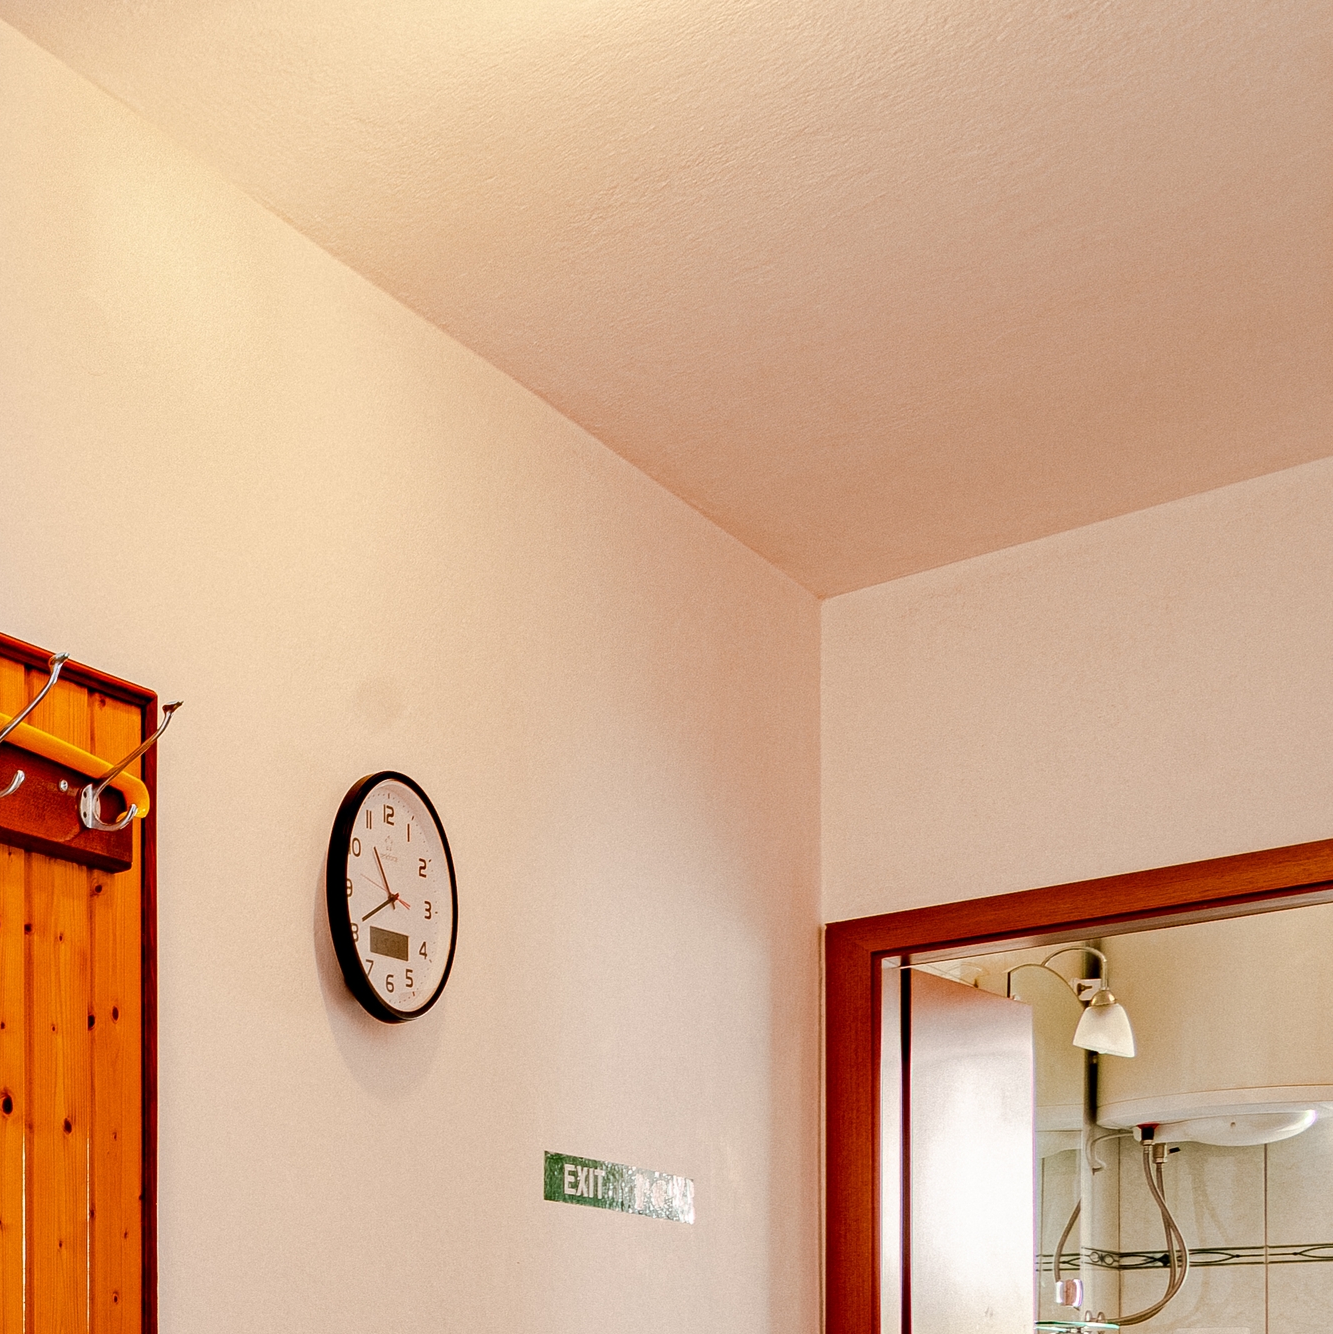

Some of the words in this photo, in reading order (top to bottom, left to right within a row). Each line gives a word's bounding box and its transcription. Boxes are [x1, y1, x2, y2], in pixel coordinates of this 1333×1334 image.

[383, 803, 395, 826] 12
[349, 837, 362, 858] 0
[418, 857, 428, 879] 2
[424, 900, 432, 921] 3
[419, 941, 428, 960] 4
[365, 959, 374, 977] 7
[405, 968, 414, 988] 5
[385, 974, 395, 993] 6
[563, 1163, 606, 1200] EXIT
